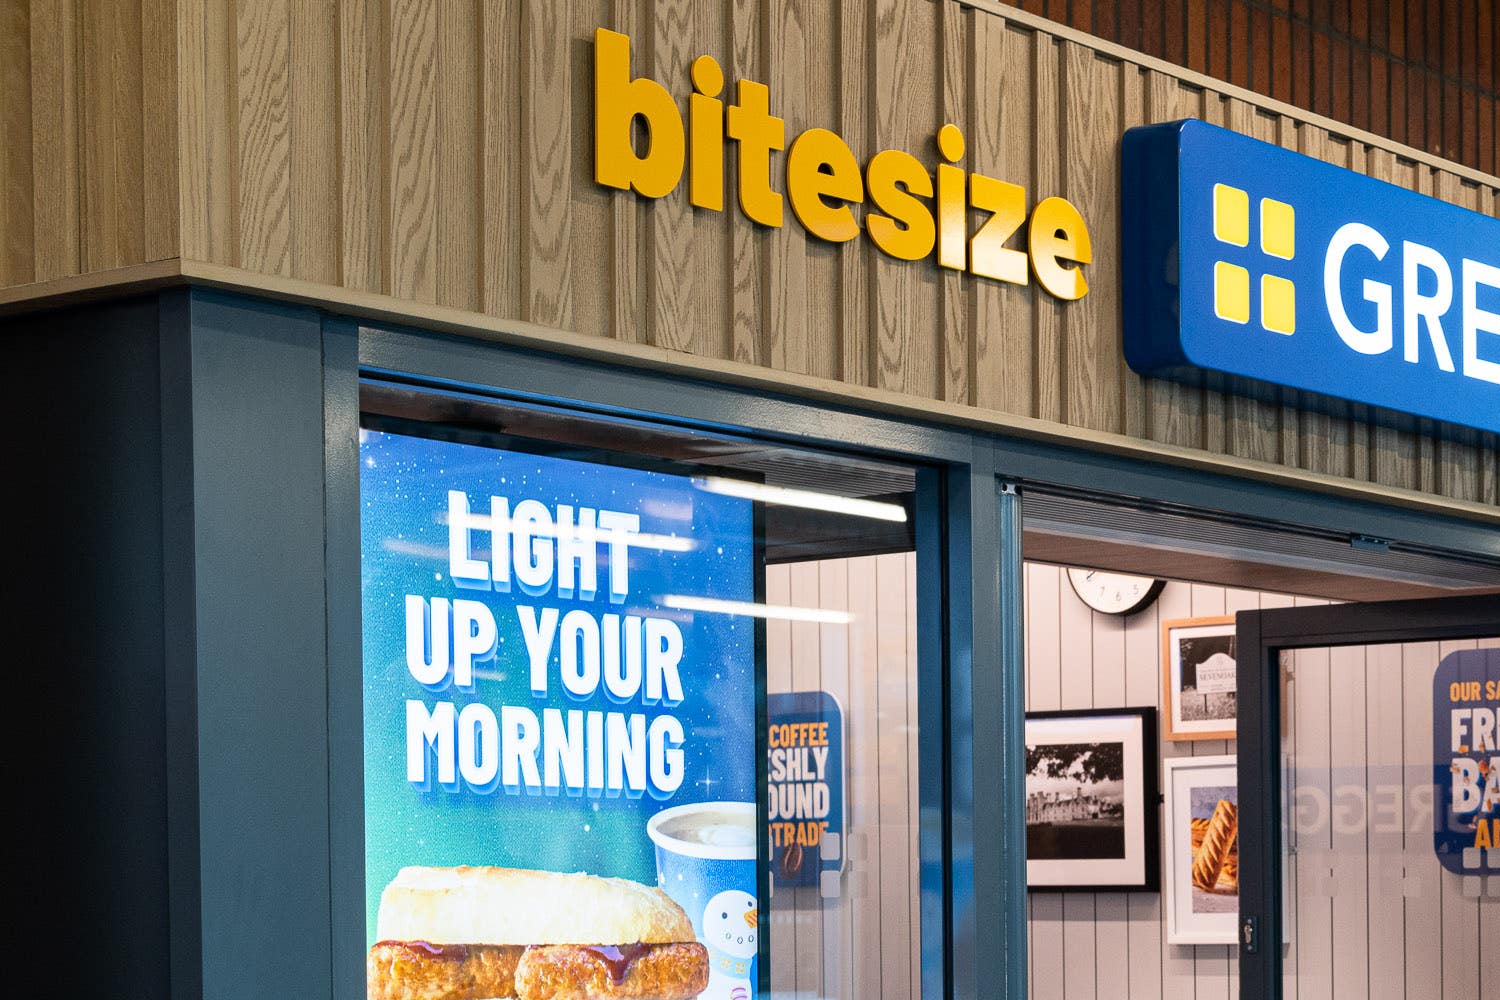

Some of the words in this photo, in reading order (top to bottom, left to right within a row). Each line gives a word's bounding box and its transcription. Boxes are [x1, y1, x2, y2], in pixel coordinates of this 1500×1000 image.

[595, 27, 1092, 300] bitesize
[448, 489, 640, 602] LIGHT
[405, 594, 497, 692] UP
[516, 605, 685, 706] YOUR
[1450, 681, 1481, 702] OUR
[405, 699, 685, 798] MORNING
[769, 722, 829, 748] COFFEE
